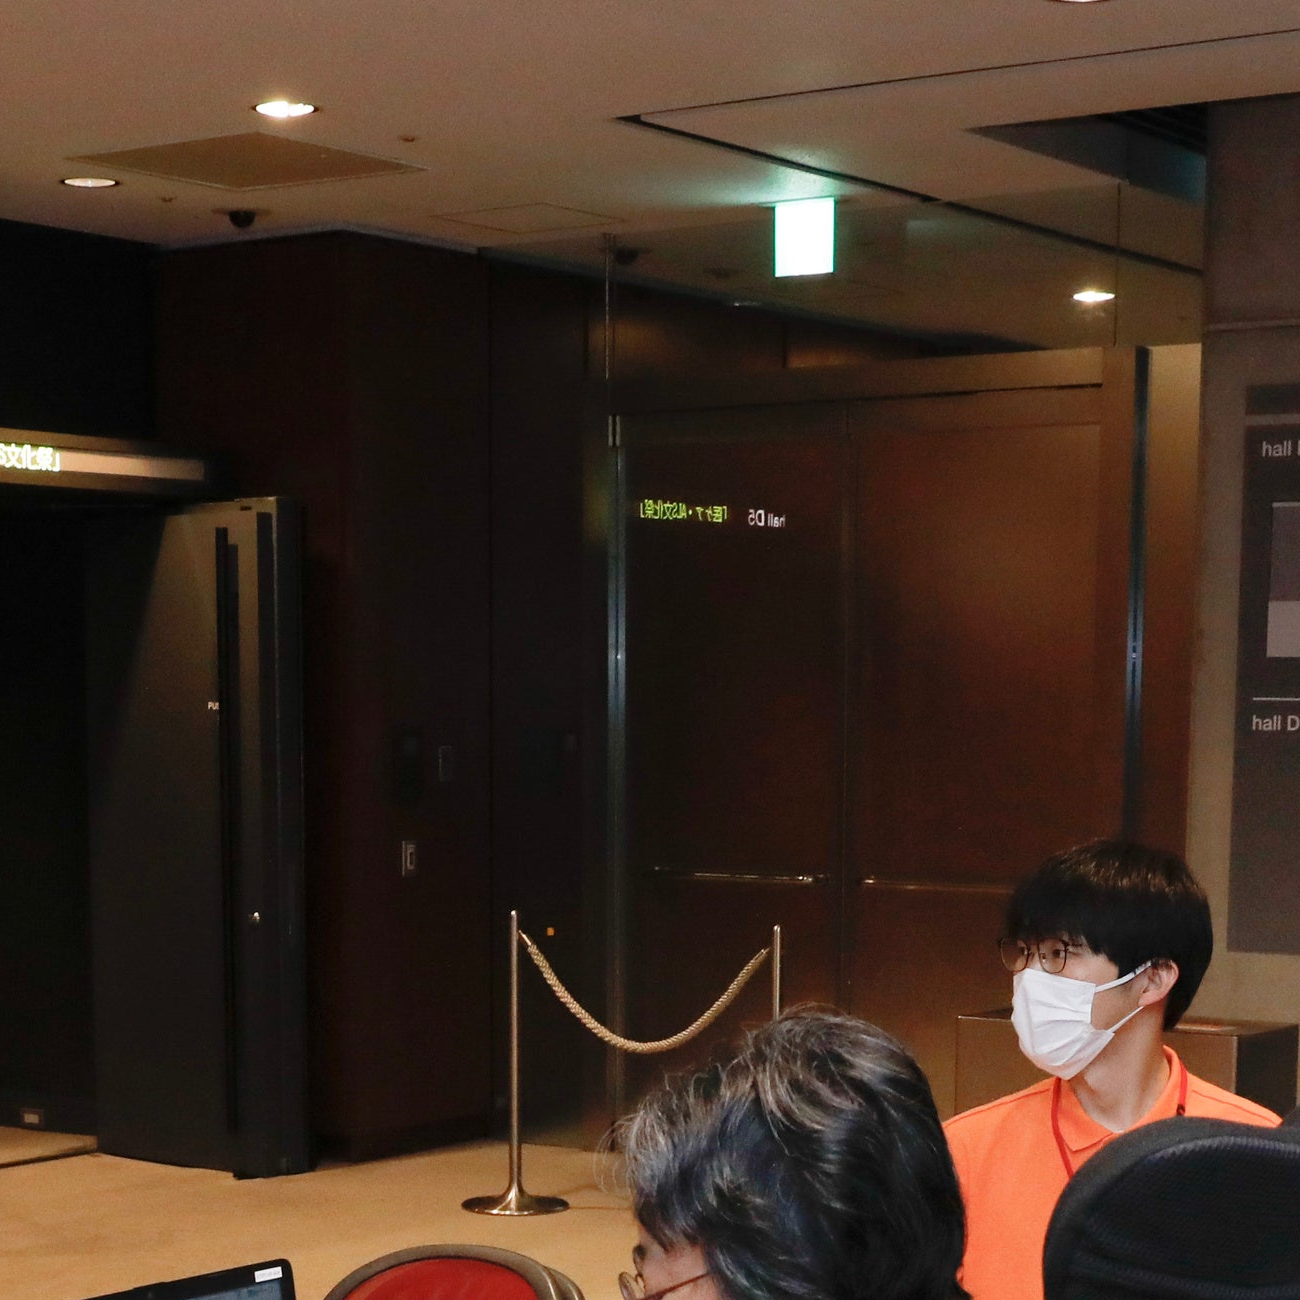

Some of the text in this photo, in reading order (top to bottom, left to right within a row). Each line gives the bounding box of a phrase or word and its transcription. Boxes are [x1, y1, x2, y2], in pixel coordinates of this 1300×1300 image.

[1262, 439, 1293, 457] hall
[1252, 714, 1283, 732] hall
[1287, 714, 1300, 732] D
